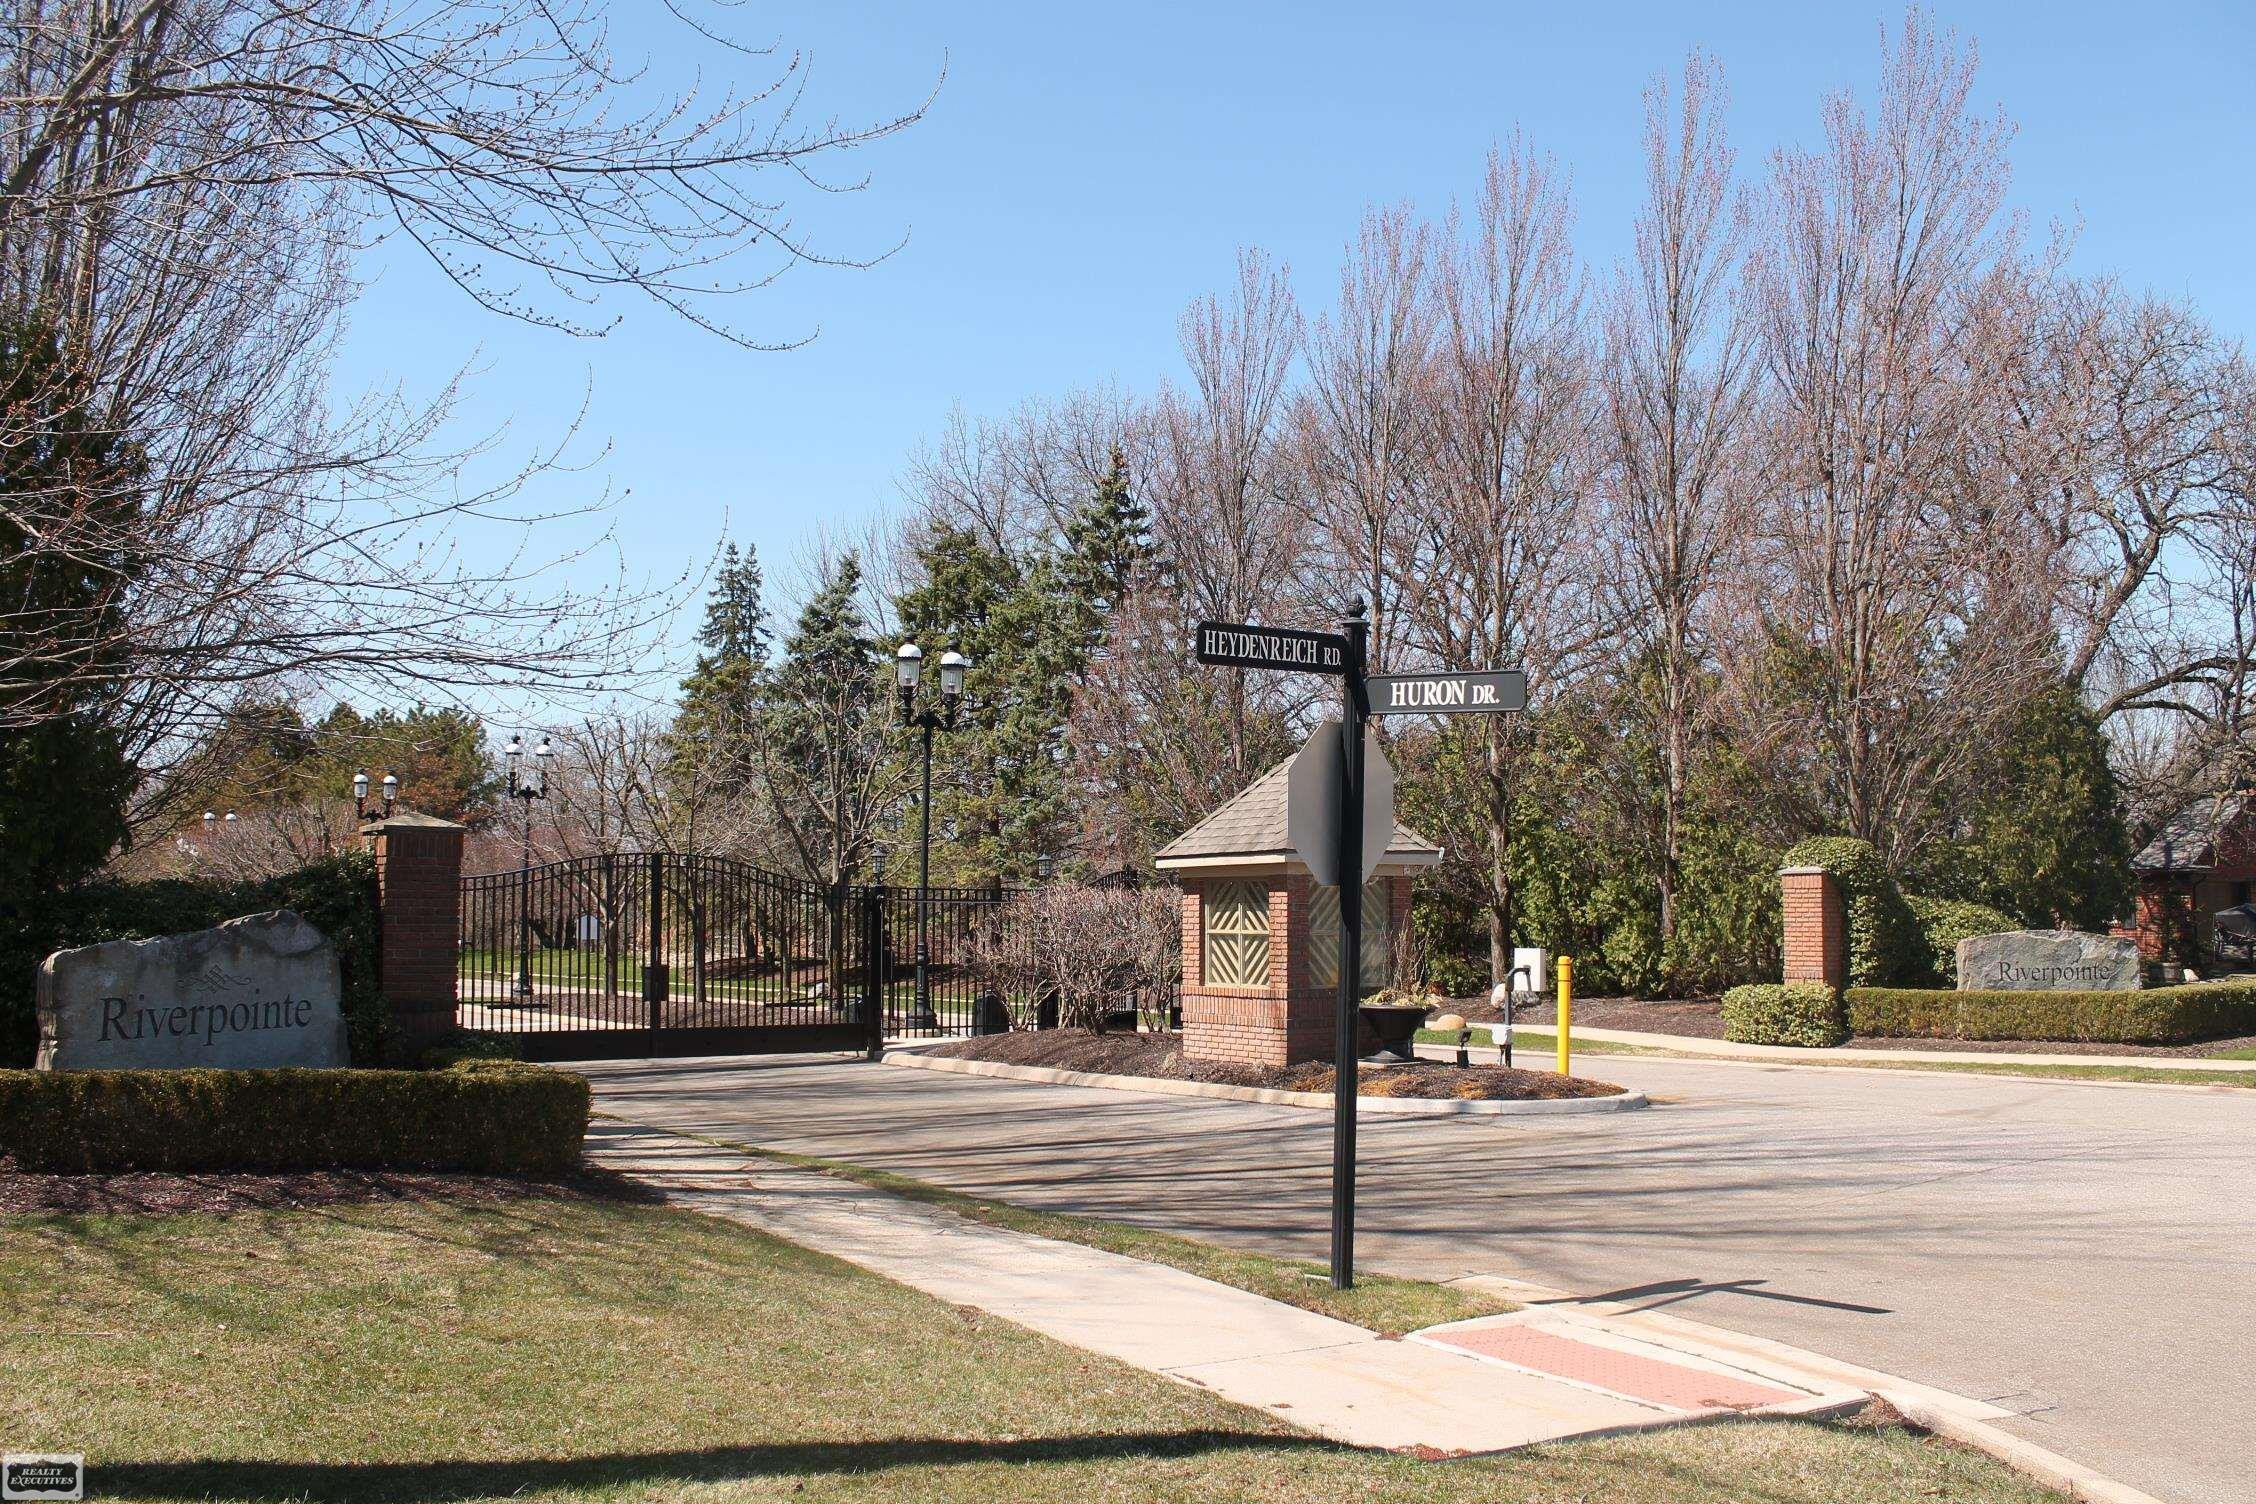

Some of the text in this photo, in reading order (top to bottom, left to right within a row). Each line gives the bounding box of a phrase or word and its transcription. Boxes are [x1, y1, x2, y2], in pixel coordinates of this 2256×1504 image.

[1203, 629, 1342, 666] HEYDENREICH RD.
[1390, 680, 1501, 707] HURON DR.
[1998, 961, 2111, 986] Riverpointe
[97, 988, 312, 1047] Riverpointe
